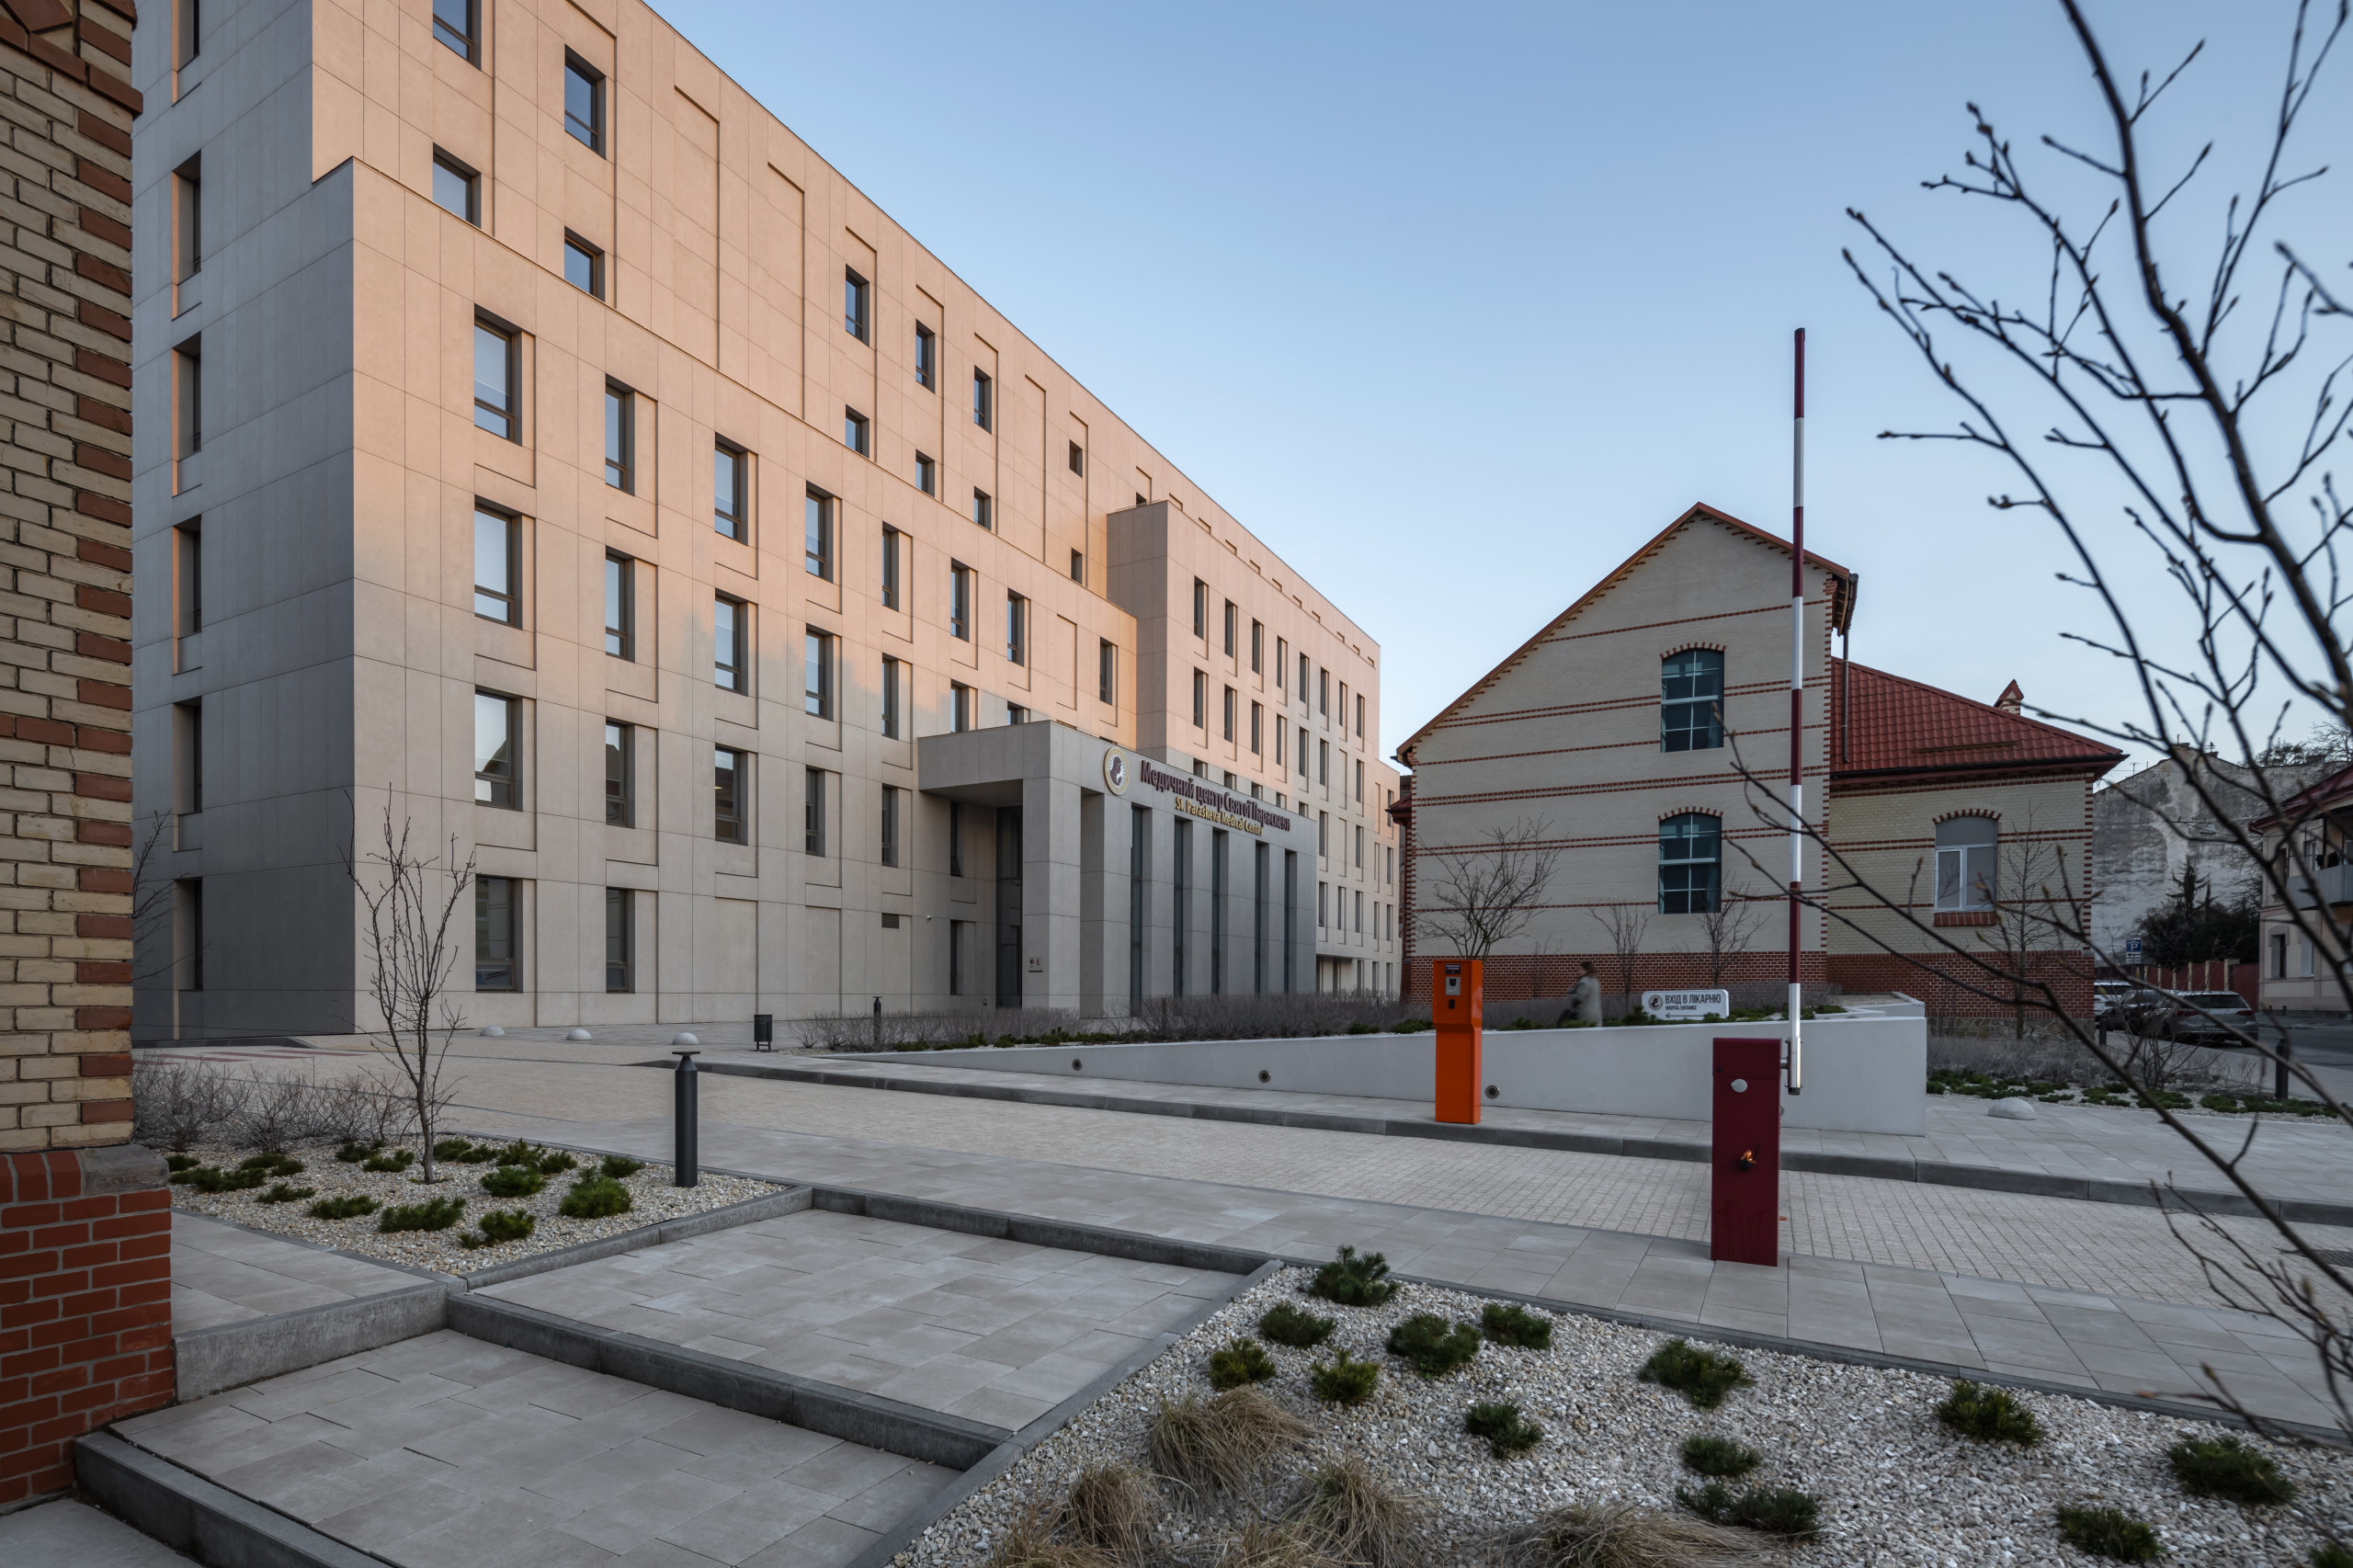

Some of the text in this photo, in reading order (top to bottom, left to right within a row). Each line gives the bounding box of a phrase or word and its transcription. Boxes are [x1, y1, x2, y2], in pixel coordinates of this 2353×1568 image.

[1141, 760, 1194, 799] Медичний
[1196, 786, 1222, 812] центр
[1223, 791, 1251, 819] Святої
[1251, 801, 1290, 832] Параскеви
[1175, 796, 1264, 837] St. Paraskeva Medical Center
[1665, 994, 1722, 1005] ВХІД В ЛІКАРНЮ
